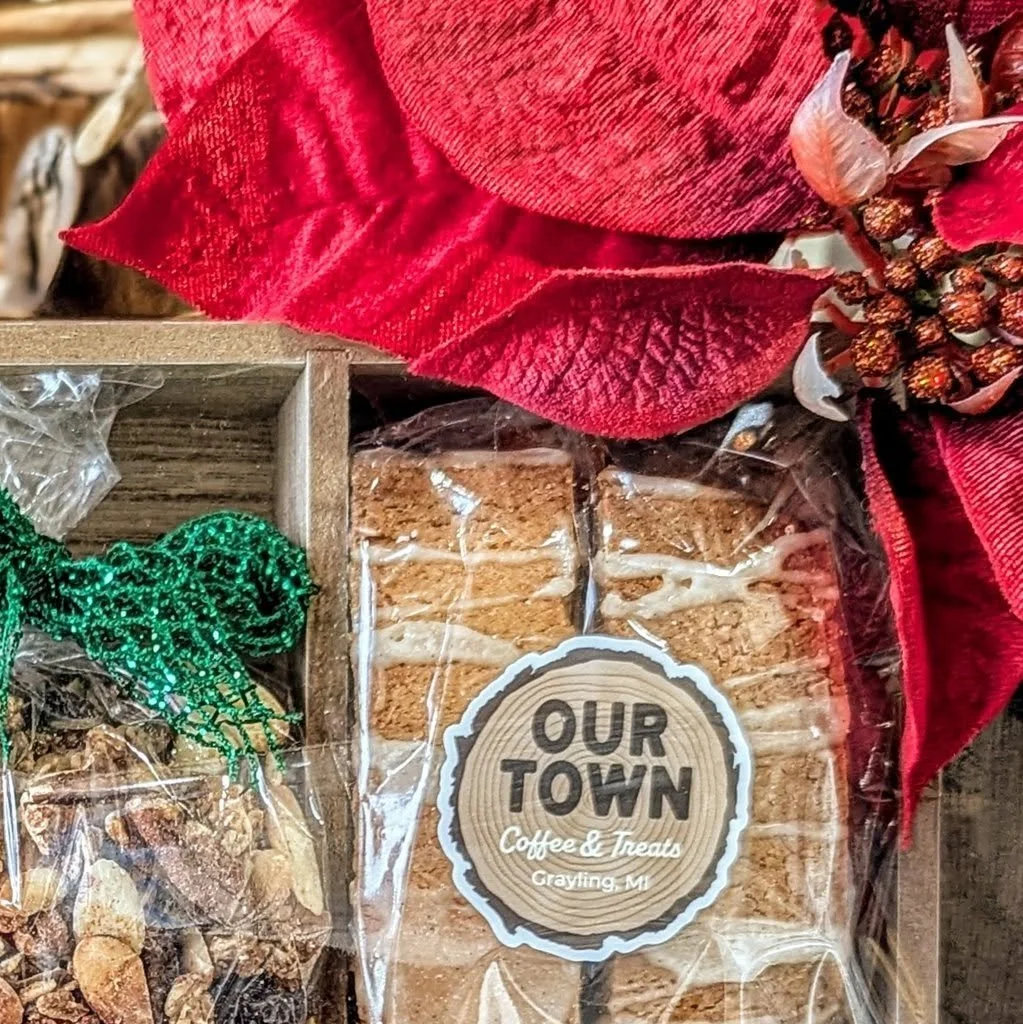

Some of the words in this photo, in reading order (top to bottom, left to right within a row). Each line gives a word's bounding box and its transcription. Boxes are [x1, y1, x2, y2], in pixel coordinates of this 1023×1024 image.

[531, 699, 668, 758] OUR
[500, 758, 693, 821] TOWN
[499, 825, 577, 861] Coffee
[579, 829, 604, 858] &
[610, 830, 682, 859] Treats
[531, 870, 620, 893] Grayling,
[625, 874, 649, 890] MI
